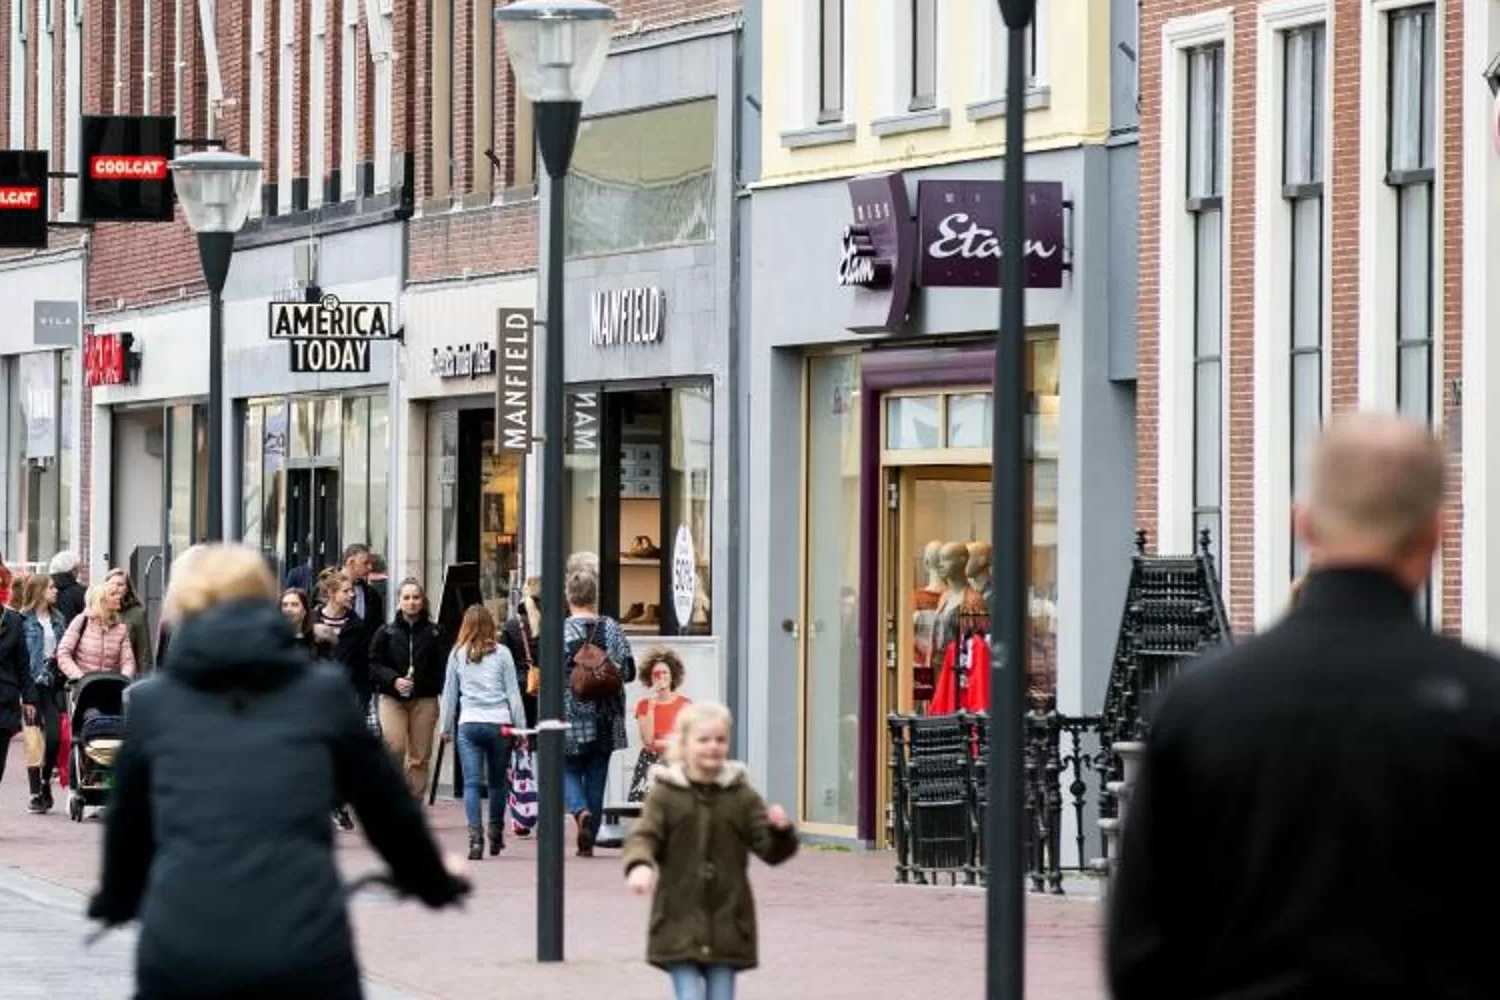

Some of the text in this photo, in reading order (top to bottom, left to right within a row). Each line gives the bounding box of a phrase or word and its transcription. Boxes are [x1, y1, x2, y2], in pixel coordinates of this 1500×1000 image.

[95, 160, 162, 175] COOLCAT
[275, 305, 387, 336] AMERICA
[589, 286, 664, 346] MANFIELD
[293, 340, 368, 371] TODAY
[503, 313, 529, 450] MANFIELD
